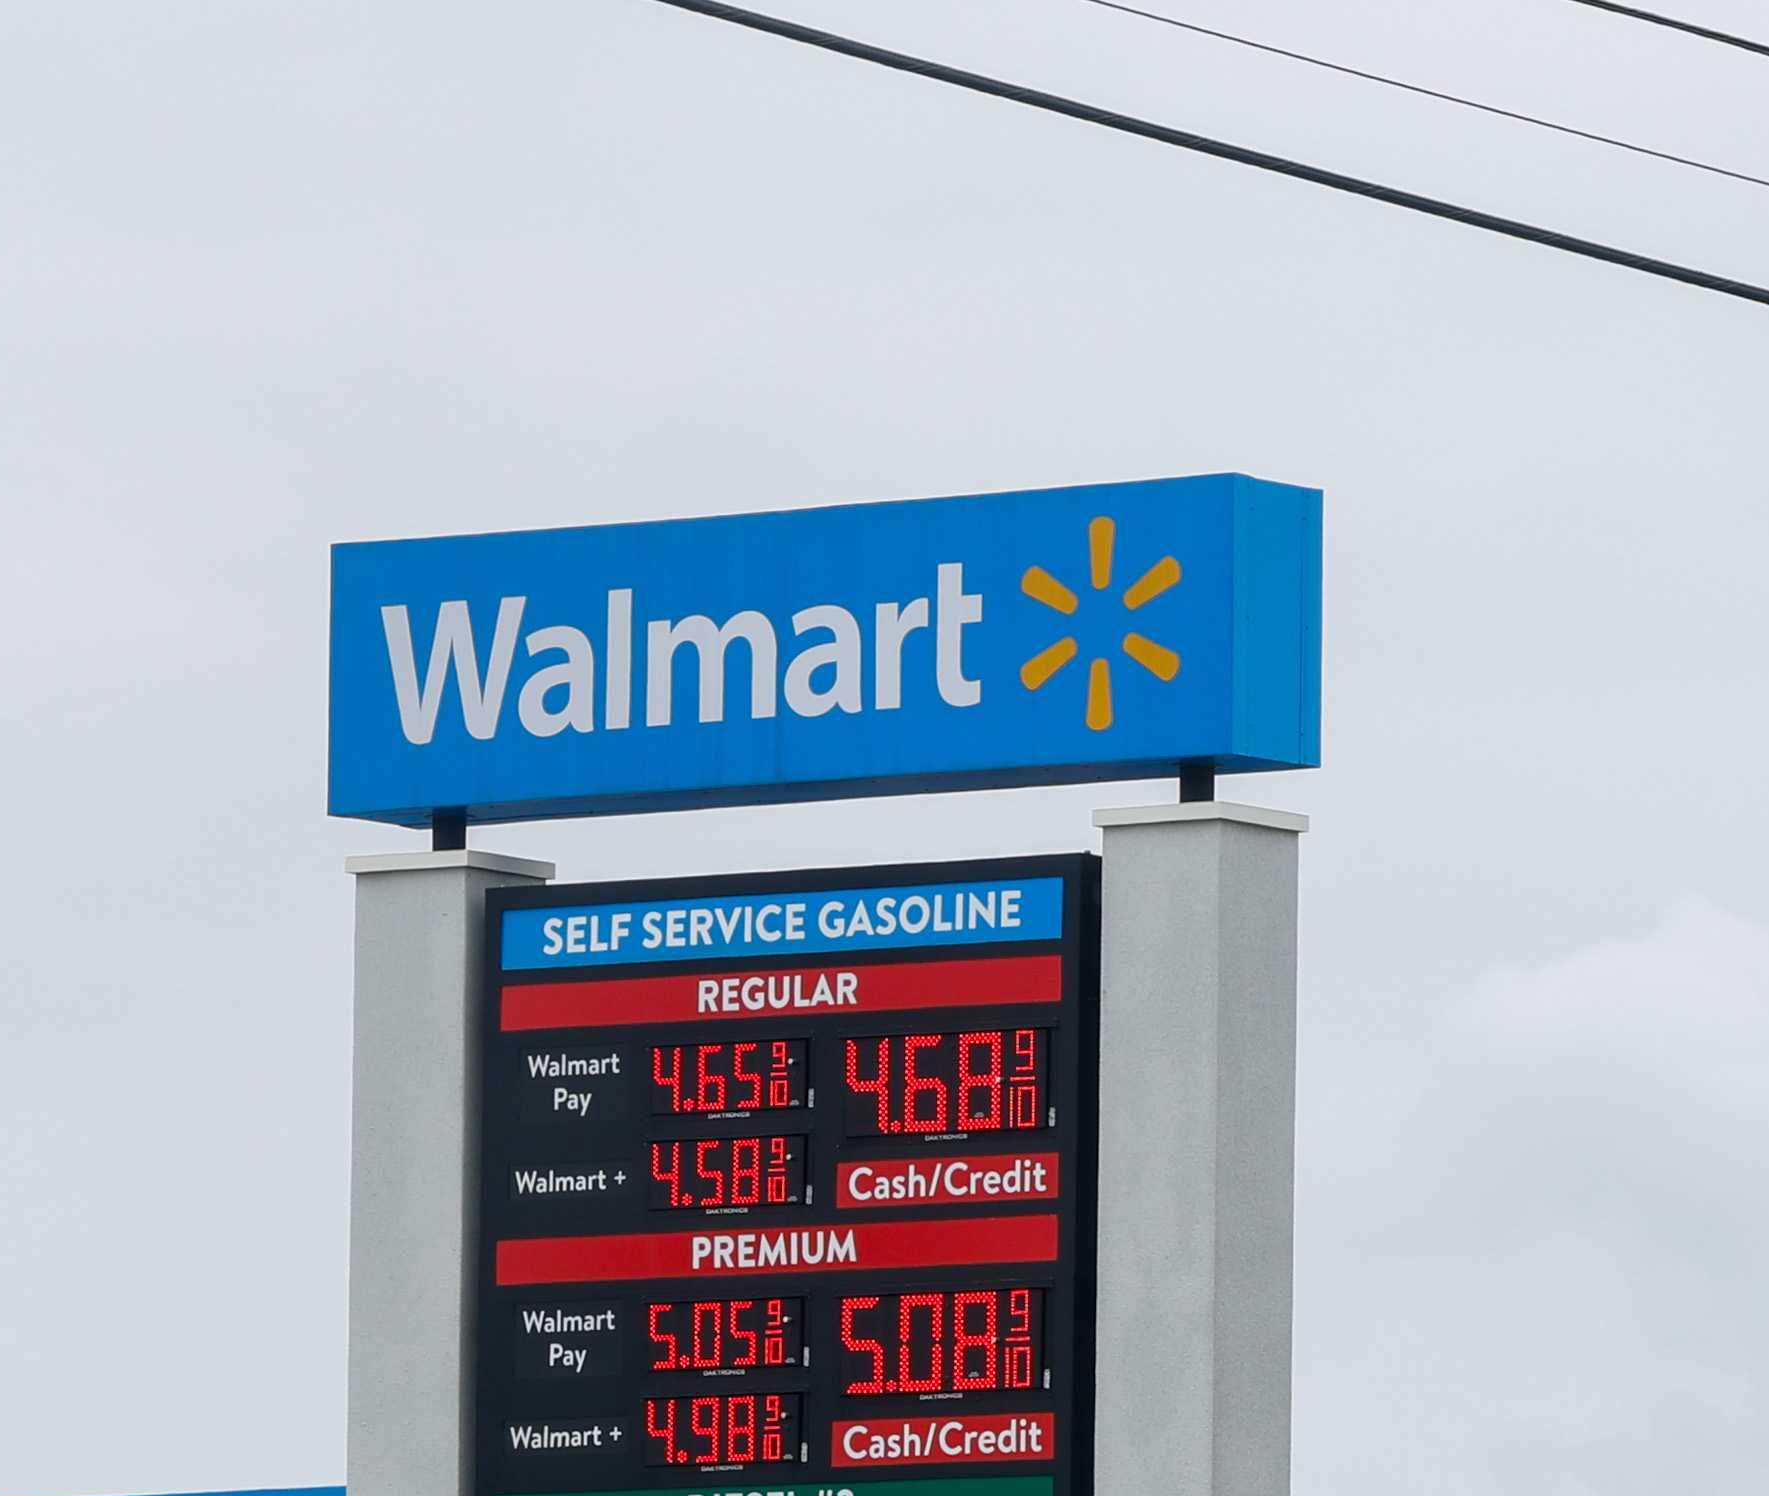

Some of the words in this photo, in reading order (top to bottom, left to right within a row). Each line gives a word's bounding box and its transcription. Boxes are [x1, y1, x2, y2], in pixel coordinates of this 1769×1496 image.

[381, 562, 983, 745] Walmart
[542, 912, 631, 955] SELF
[641, 901, 806, 949] SERVICE
[817, 890, 1022, 939] GASOLINE
[697, 972, 859, 1013] REGULAR
[527, 1053, 620, 1077] Walmart
[651, 1042, 762, 1112] 4.65
[845, 1031, 1002, 1134] 4.68
[553, 1088, 592, 1116] Pay
[515, 1169, 608, 1193] Walmart
[650, 1137, 760, 1207] 4.58
[848, 1159, 1048, 1202] Cash/Credit
[691, 1230, 858, 1270] PREMIUM
[523, 1309, 616, 1334] Walmart
[648, 1300, 757, 1369] 5.05
[840, 1291, 998, 1394] 5.08
[548, 1345, 588, 1372] Pay
[510, 1425, 603, 1450] Walmart
[646, 1395, 755, 1464] 4.98
[842, 1419, 1043, 1462] Cash/Credit
